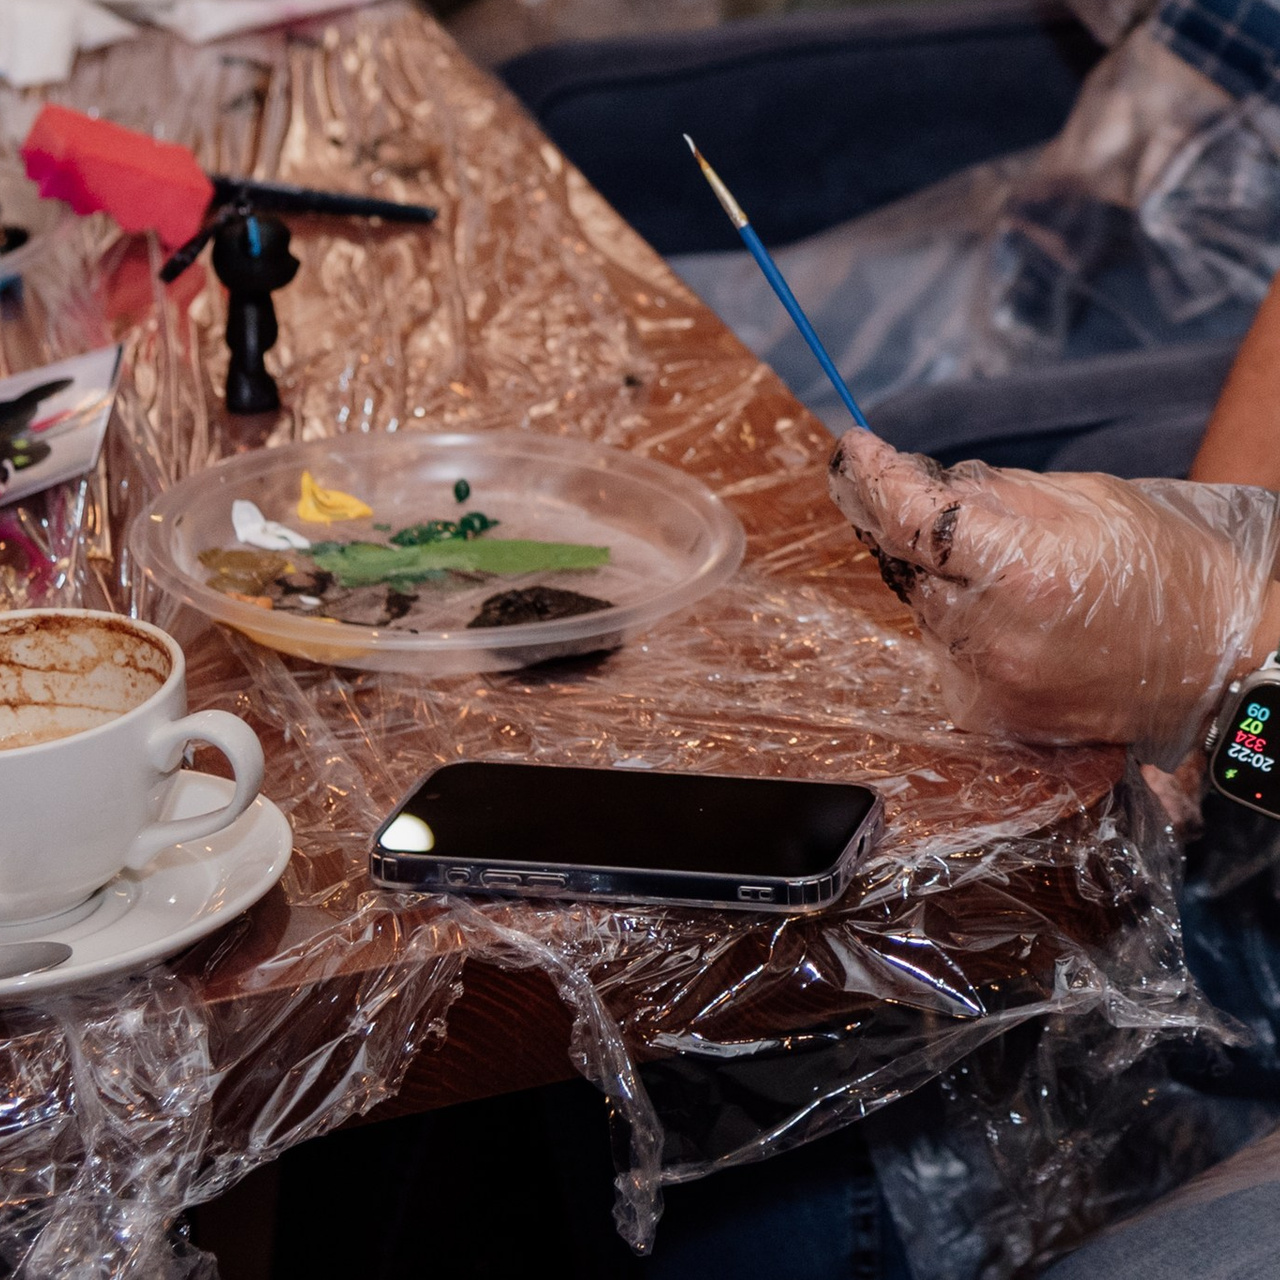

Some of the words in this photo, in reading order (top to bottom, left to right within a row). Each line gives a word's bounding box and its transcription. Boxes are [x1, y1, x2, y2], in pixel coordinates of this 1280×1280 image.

[1247, 703, 1270, 721] 09
[1240, 718, 1263, 734] 07
[1235, 730, 1266, 752] 324
[1228, 743, 1274, 772] 20:22
